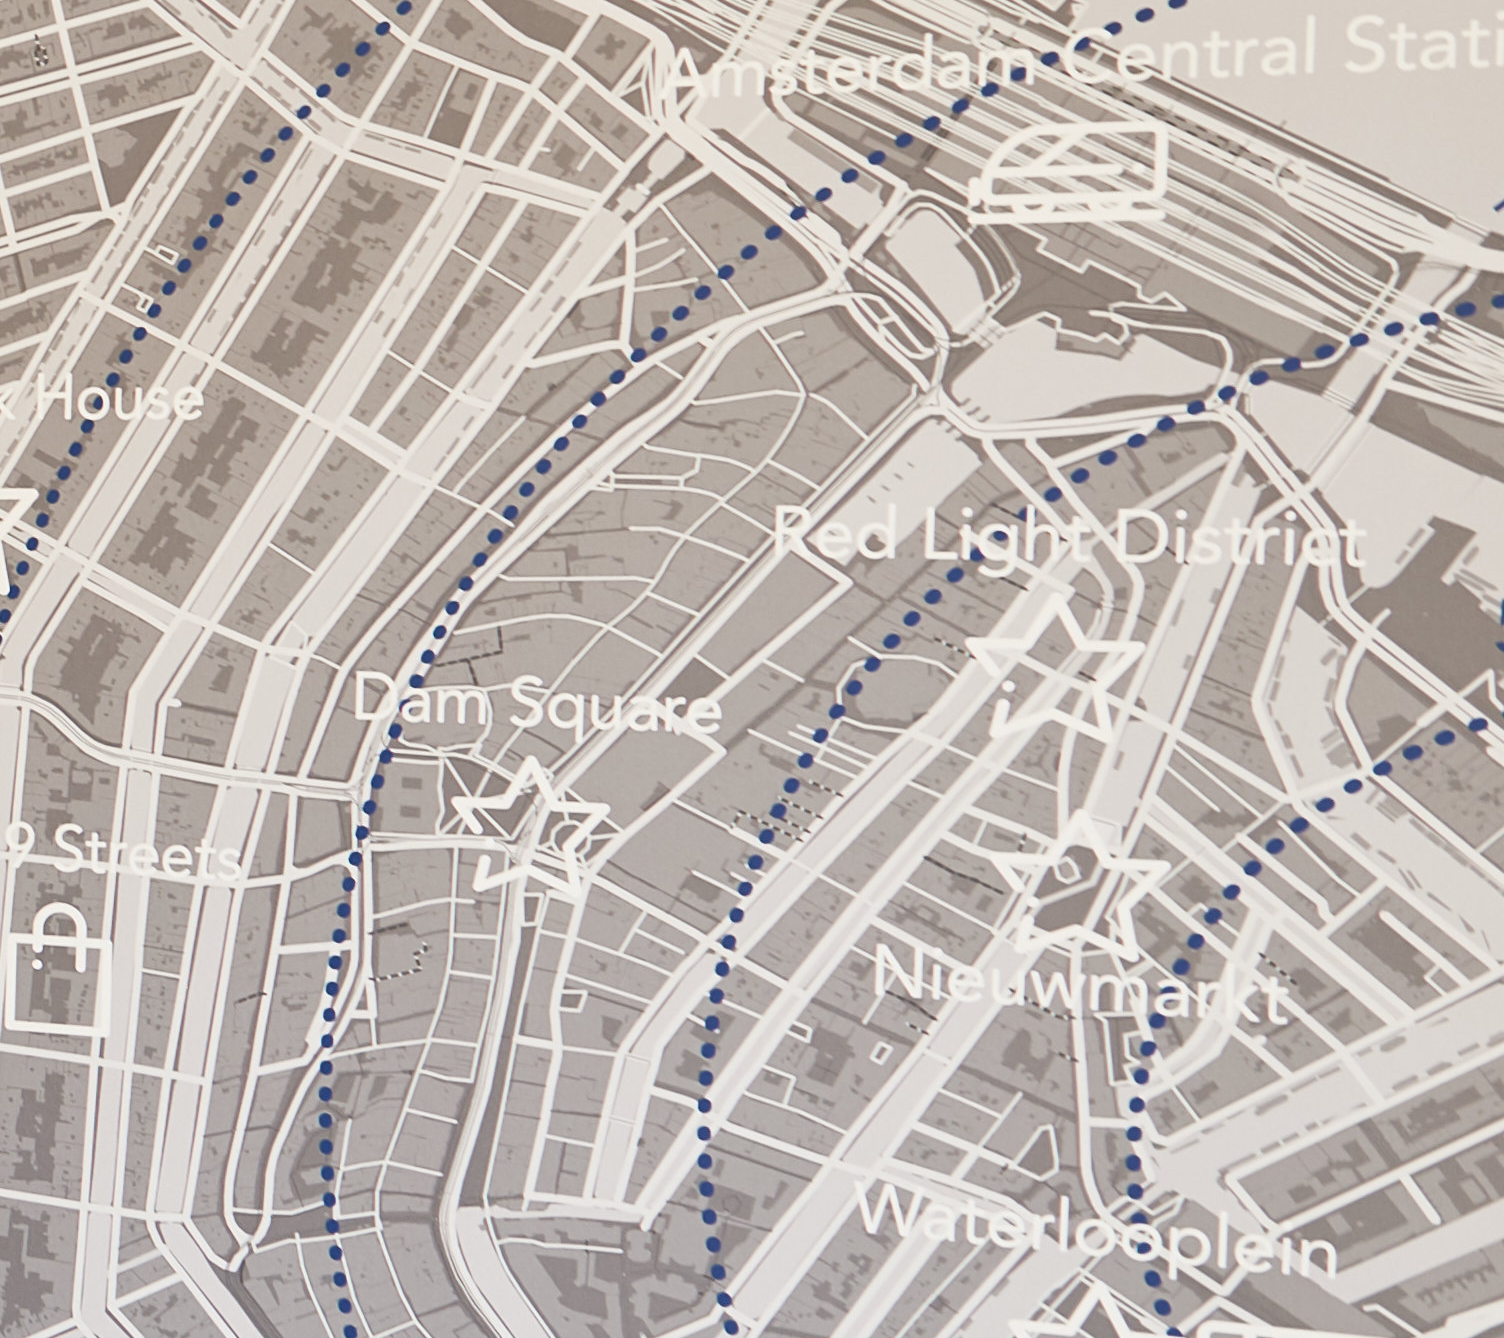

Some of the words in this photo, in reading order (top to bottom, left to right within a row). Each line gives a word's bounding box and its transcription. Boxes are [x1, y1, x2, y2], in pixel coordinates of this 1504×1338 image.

[661, 33, 1037, 99] Amsterdam
[1062, 15, 1317, 84] Central
[1344, 10, 1504, 74] Stati
[36, 372, 205, 421] House
[773, 503, 898, 562] Red
[925, 504, 1092, 577] Light
[1117, 507, 1368, 569] District
[354, 672, 489, 725] Dam
[509, 675, 724, 735] Square
[7, 819, 36, 869] 9
[52, 822, 242, 882] Streets
[873, 942, 1289, 1027] Nieuwmarkt
[854, 1180, 1337, 1279] Waterlooplein
